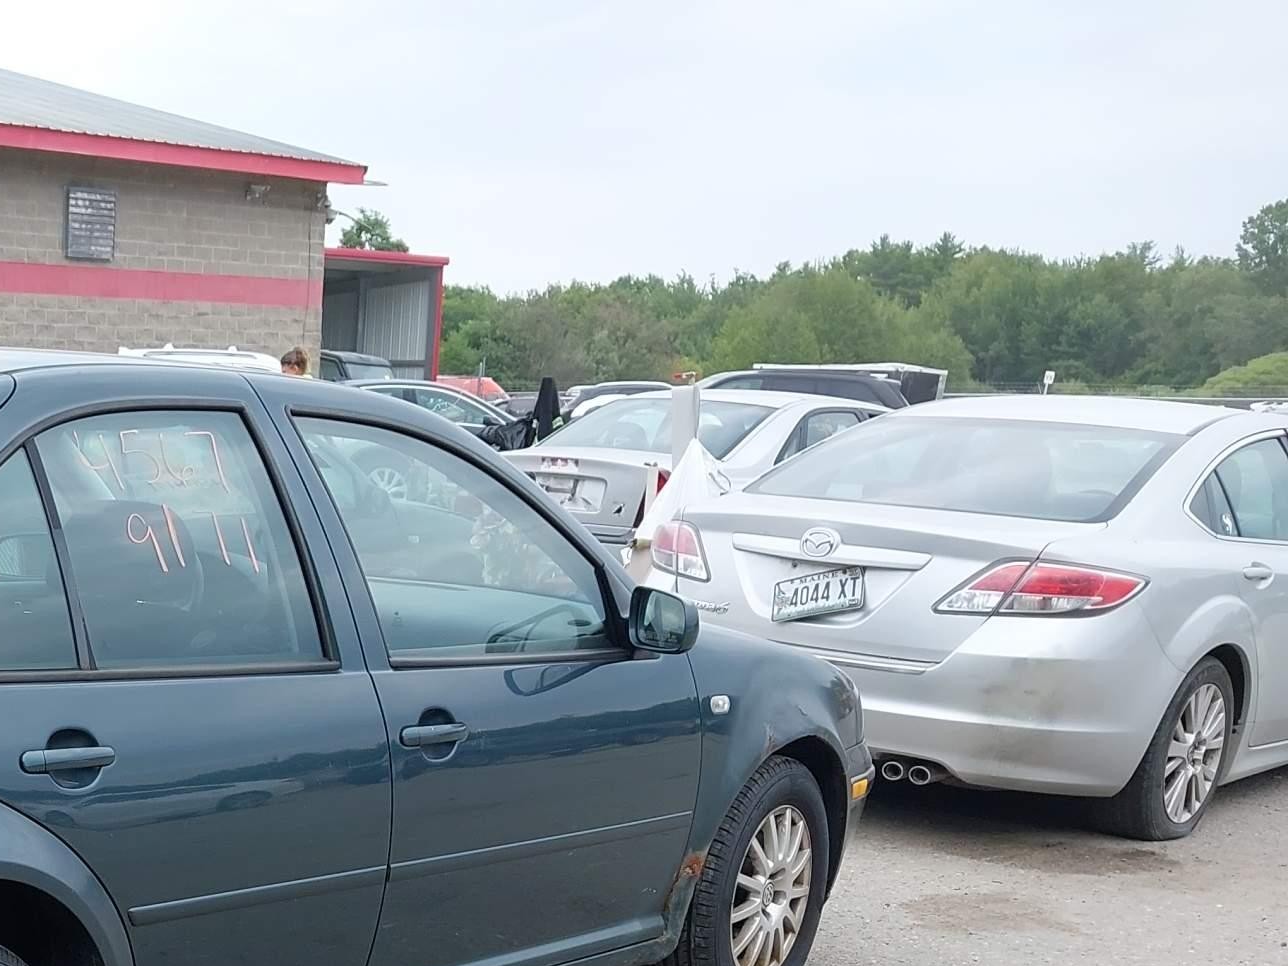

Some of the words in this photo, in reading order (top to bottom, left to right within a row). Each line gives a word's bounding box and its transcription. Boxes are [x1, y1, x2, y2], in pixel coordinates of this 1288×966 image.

[72, 429, 231, 495] 4567
[127, 503, 260, 573] 9171
[790, 581, 830, 607] 4044
[838, 576, 860, 600] XT
[800, 571, 838, 584] MAINE
